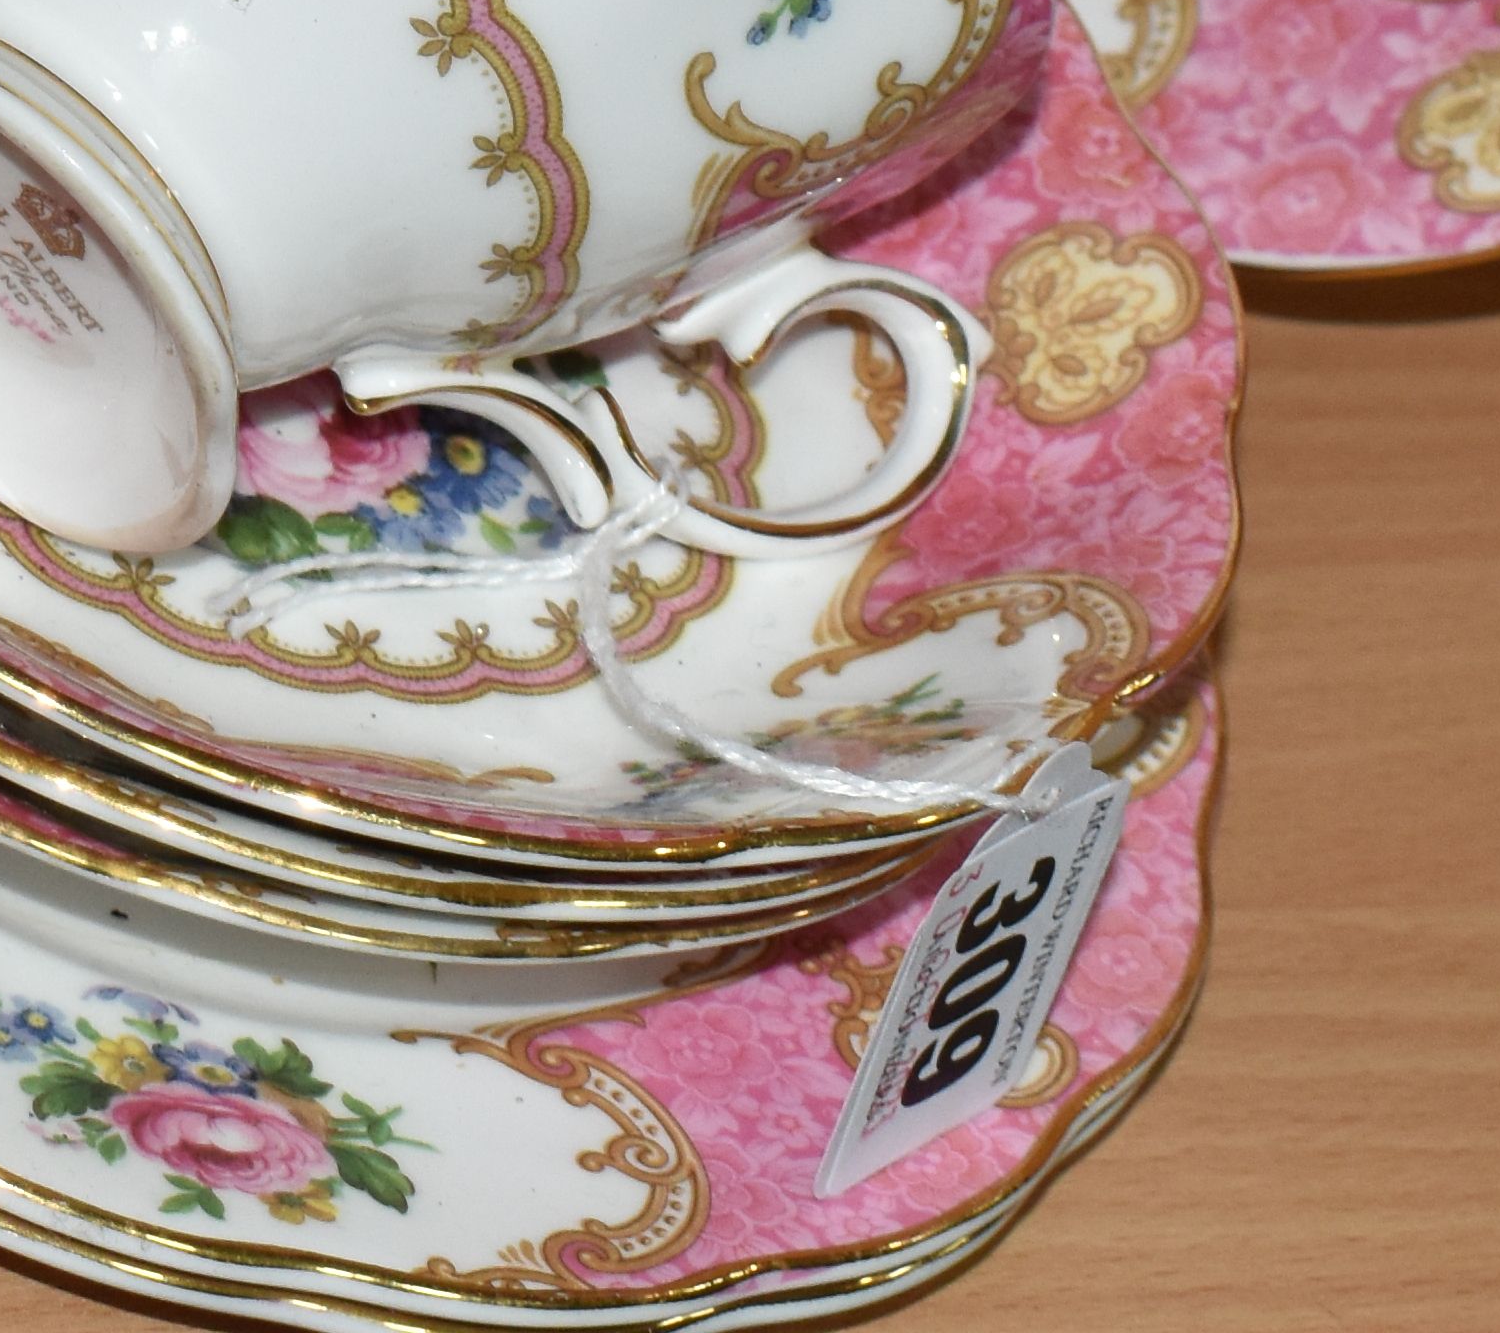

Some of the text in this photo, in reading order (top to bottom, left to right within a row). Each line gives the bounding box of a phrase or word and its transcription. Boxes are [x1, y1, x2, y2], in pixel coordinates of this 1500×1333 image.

[10, 237, 104, 332] ALBERT
[1053, 796, 1115, 921] RICHARD
[901, 855, 1056, 1107] 309
